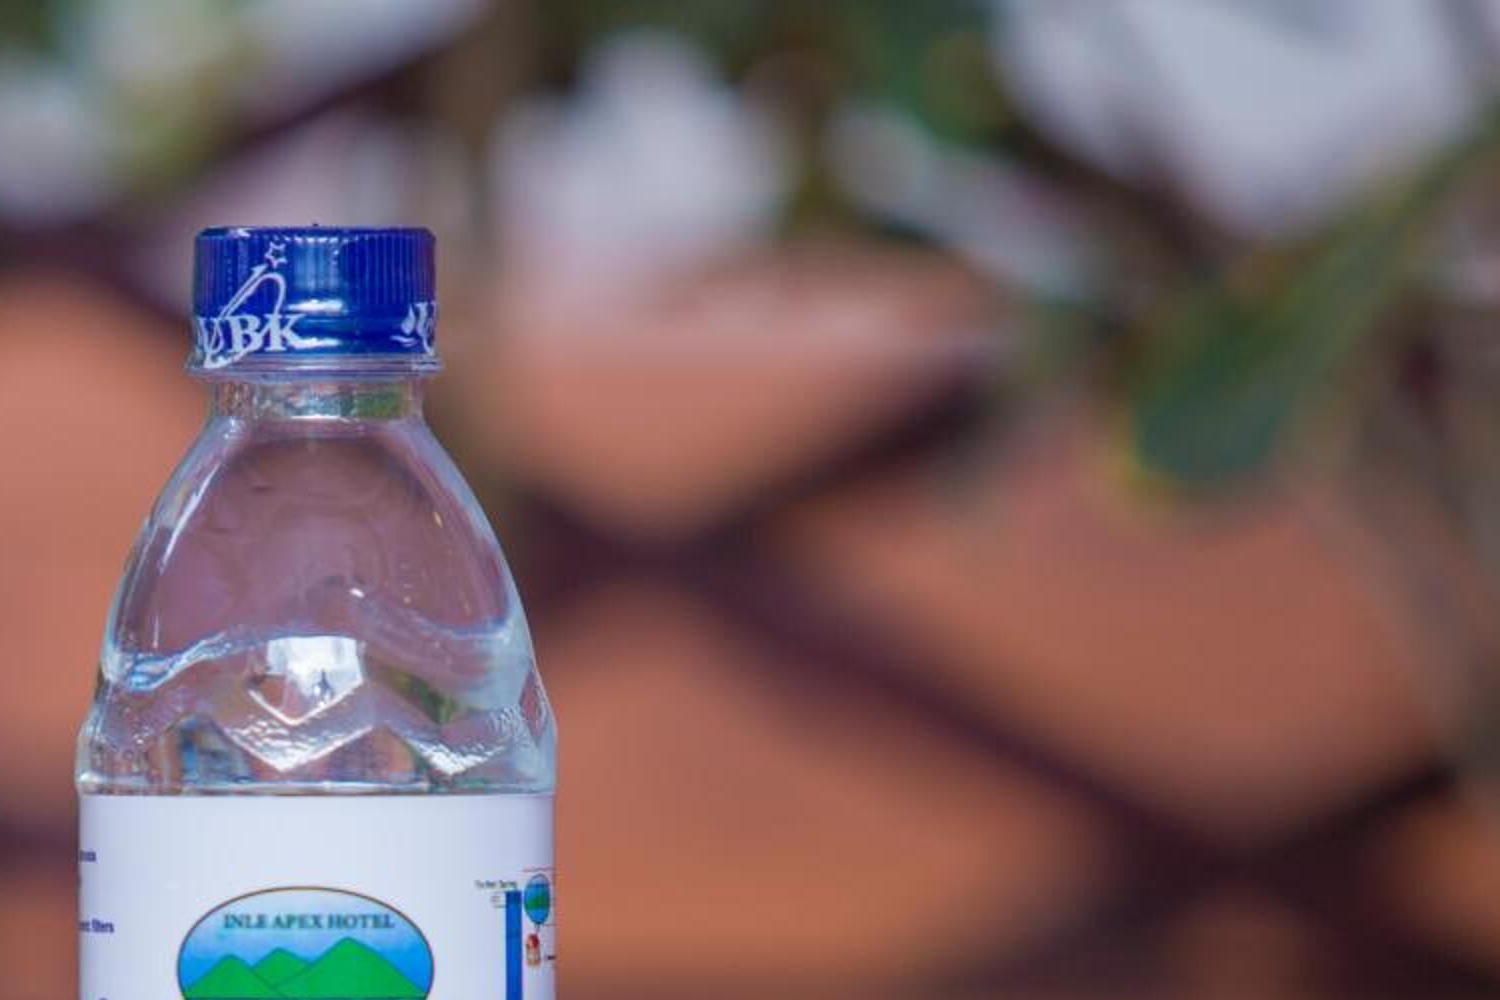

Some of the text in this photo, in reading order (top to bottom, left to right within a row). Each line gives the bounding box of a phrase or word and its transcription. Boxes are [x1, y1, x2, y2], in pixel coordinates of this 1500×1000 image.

[223, 914, 396, 929] INLE APEX HOTEL
